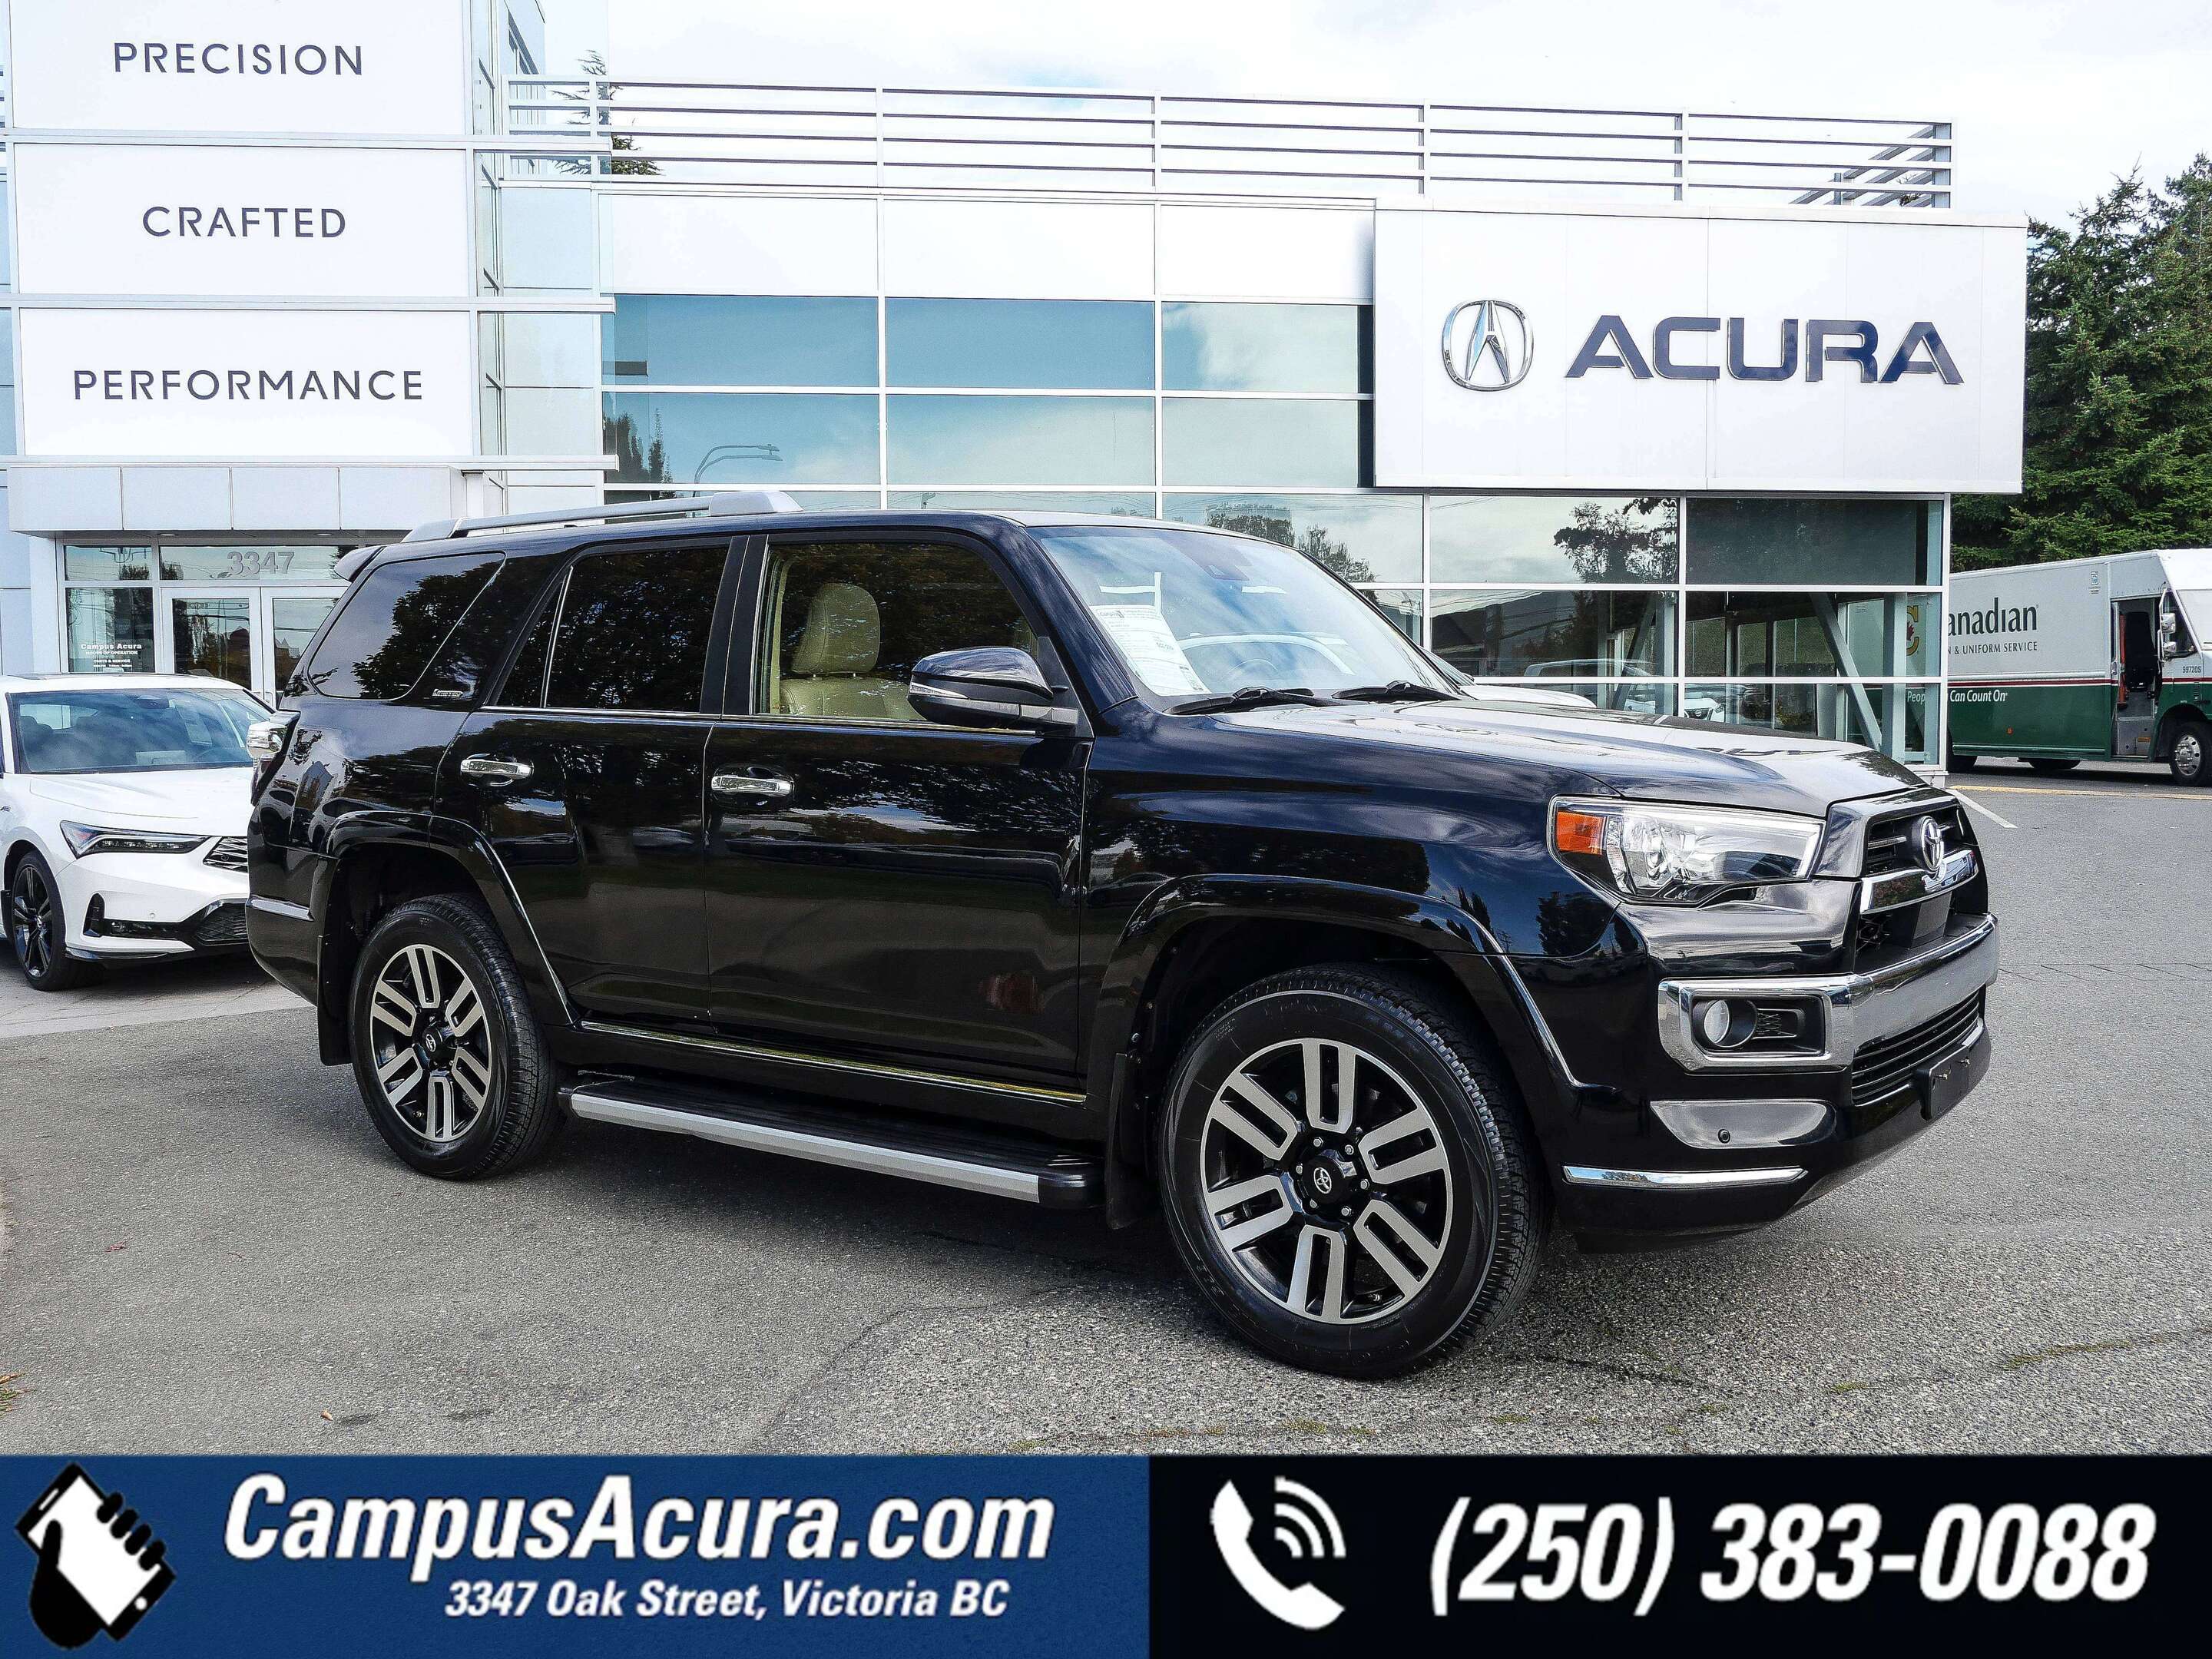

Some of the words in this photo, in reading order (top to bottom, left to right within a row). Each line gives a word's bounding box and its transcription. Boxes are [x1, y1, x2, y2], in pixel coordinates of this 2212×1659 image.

[114, 42, 363, 75] PRECISION
[143, 206, 346, 238] CRAFTED
[1565, 315, 1965, 386] ACURA
[75, 369, 422, 400] PERFORMANCE
[227, 551, 295, 575] 3347
[1954, 645, 1960, 654] &
[1962, 643, 2001, 654] UNIFORM
[2003, 641, 2038, 652] SERVICE
[1907, 690, 1926, 705] Peop
[1950, 690, 1965, 702] Can
[1966, 690, 1992, 702] Count
